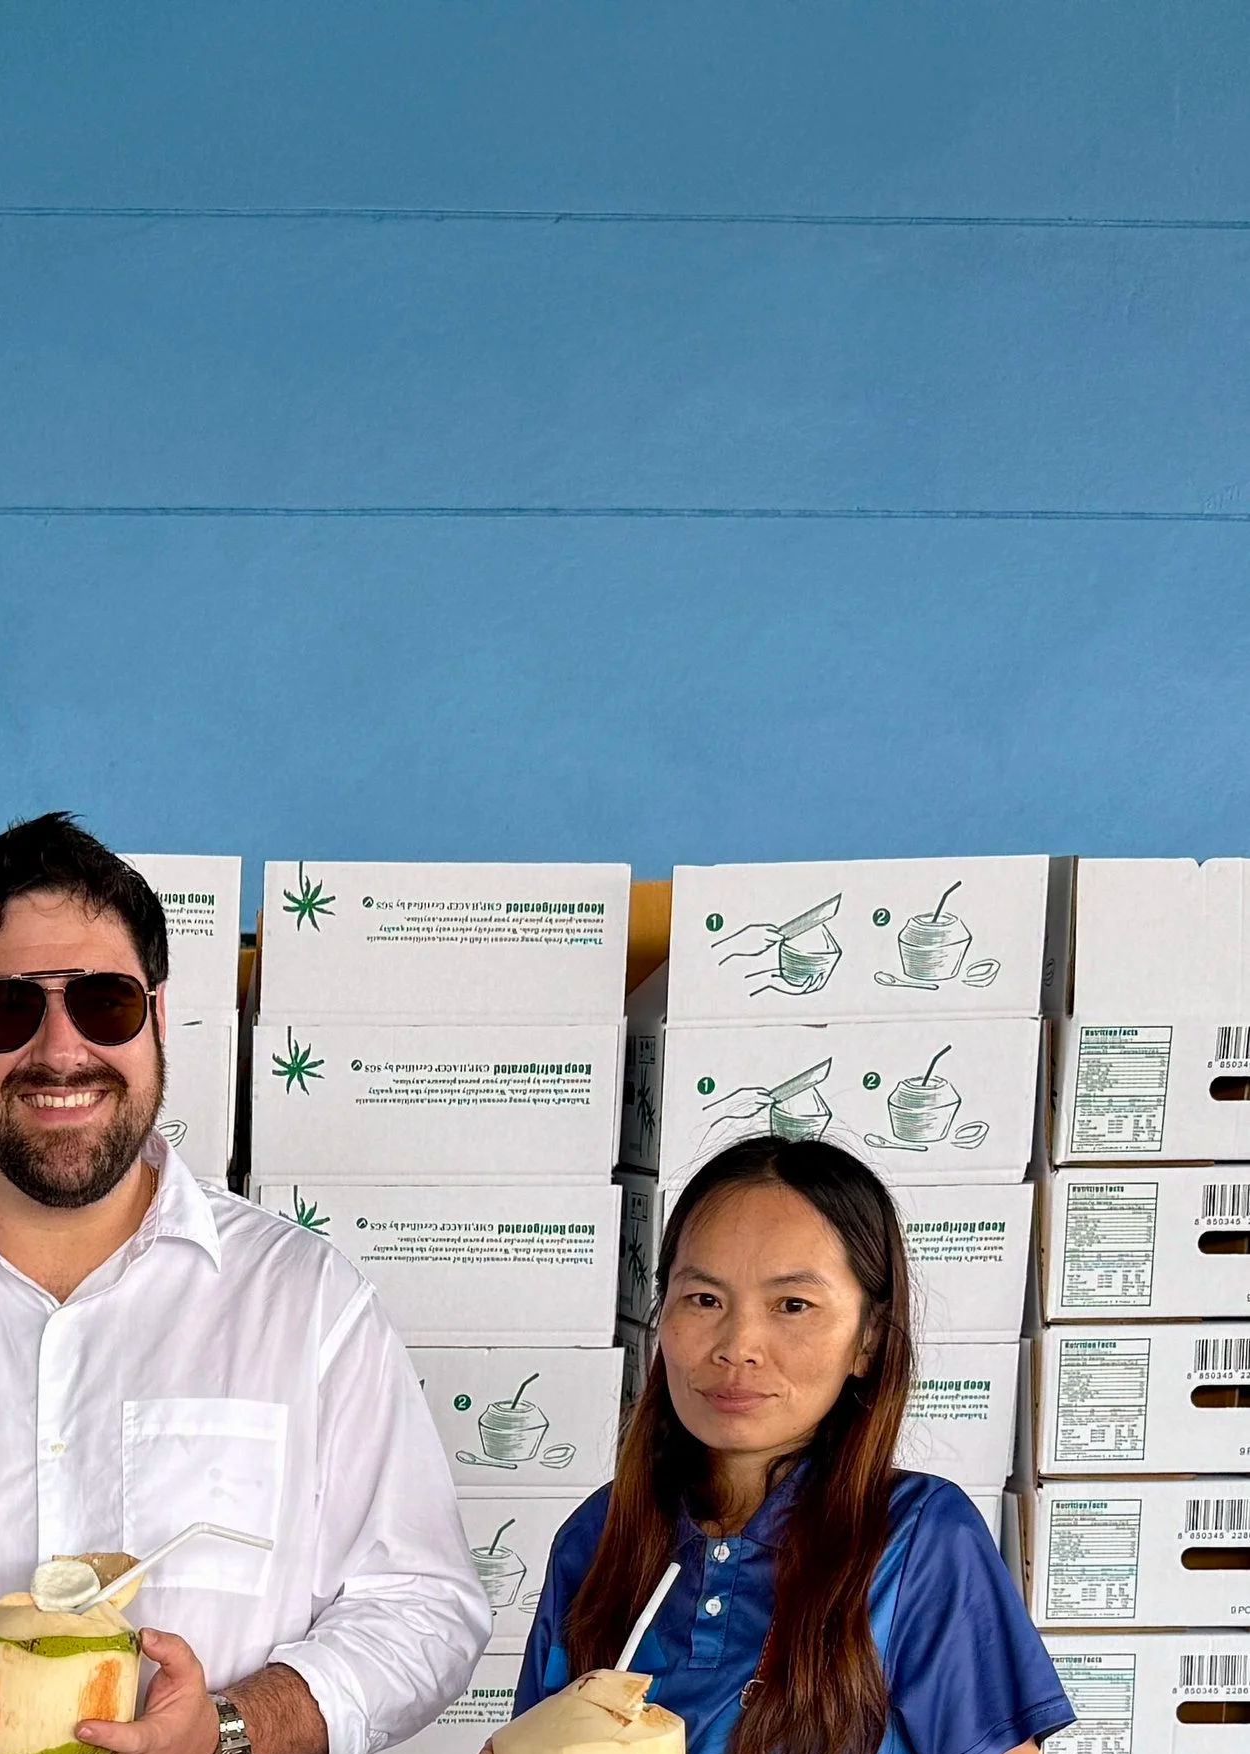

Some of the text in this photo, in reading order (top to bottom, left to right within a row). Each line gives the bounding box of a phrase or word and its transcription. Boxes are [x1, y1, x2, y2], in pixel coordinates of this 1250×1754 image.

[376, 901, 393, 910] SGS
[396, 900, 405, 910] by
[407, 901, 444, 911] Certified
[506, 903, 575, 914] Refrigerated
[577, 903, 604, 914] Keep
[1119, 1027, 1138, 1036] Facts
[365, 1064, 382, 1073] SGS
[385, 1063, 394, 1072] by
[395, 1064, 433, 1073] Certified
[494, 1064, 562, 1075] Refrigerated
[564, 1063, 591, 1075] Keep
[389, 1222, 399, 1231] by
[400, 1222, 437, 1231] Certified
[1206, 1218, 1241, 1226] 850345
[370, 1223, 387, 1231] SGS
[498, 1223, 566, 1234] Refrigerated
[568, 1224, 595, 1235] Keep
[907, 1222, 1005, 1233] Keep Refrigerated
[1098, 1341, 1117, 1349] Facts
[1190, 1532, 1224, 1540] 850345
